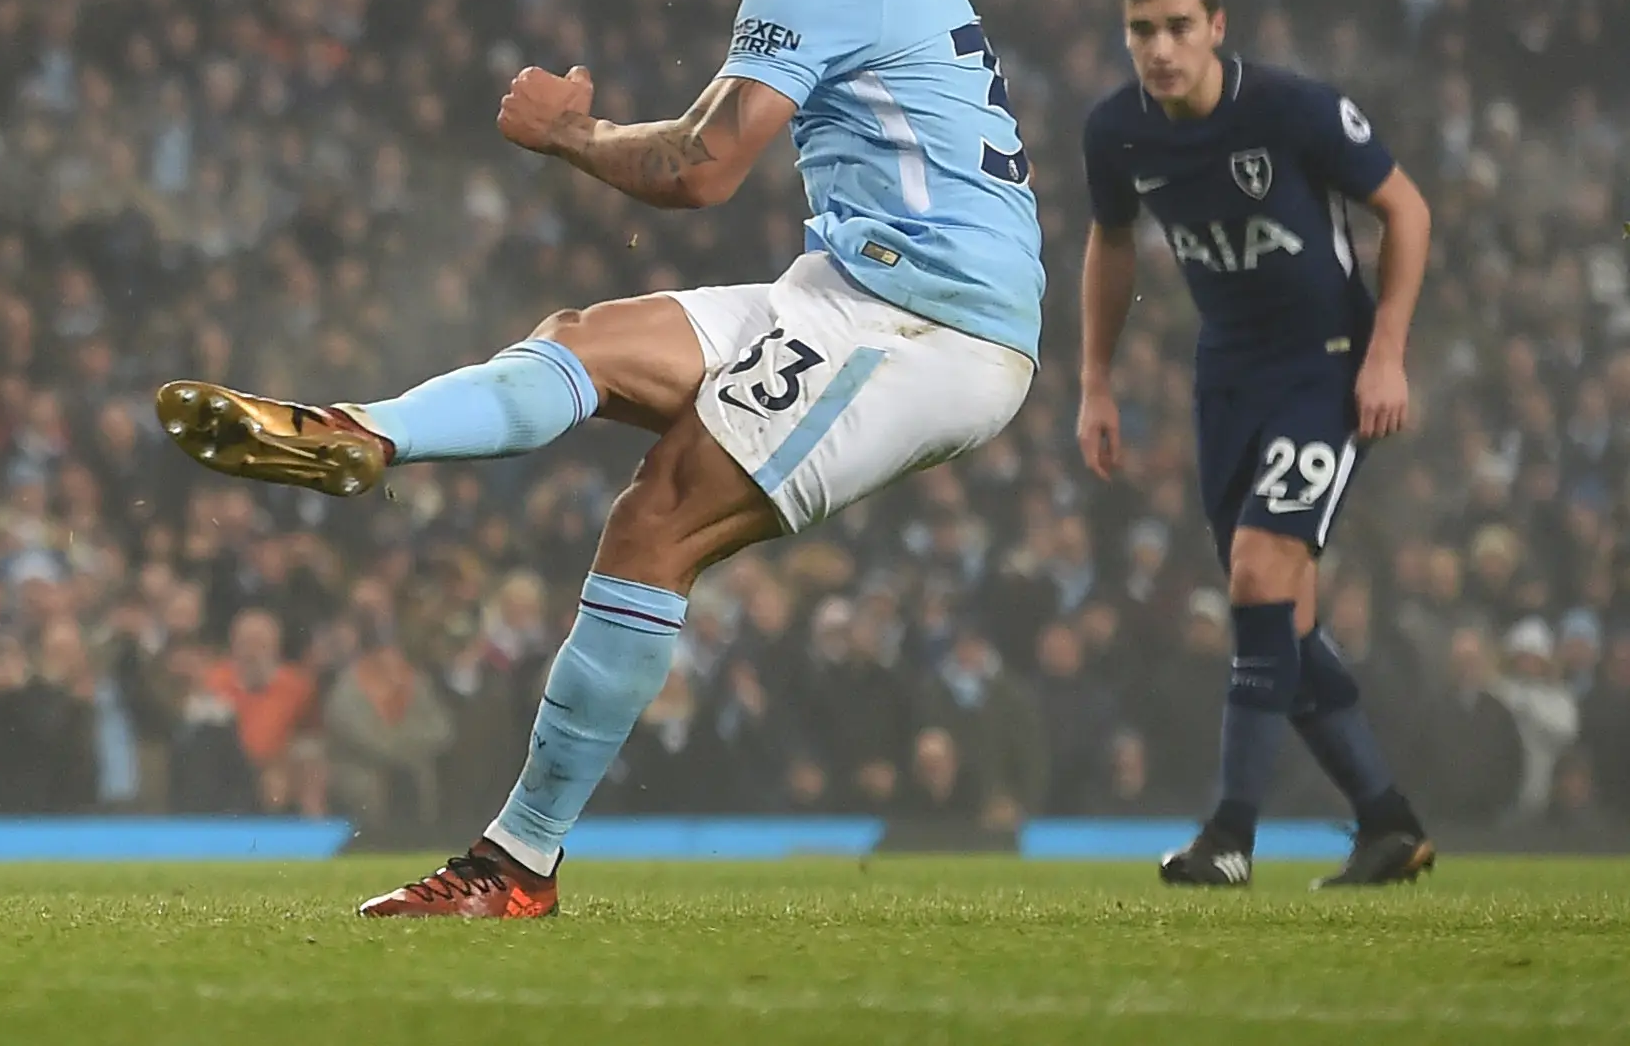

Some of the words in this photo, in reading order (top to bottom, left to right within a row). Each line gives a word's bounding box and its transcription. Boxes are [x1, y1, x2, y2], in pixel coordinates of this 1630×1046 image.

[734, 19, 802, 52] EXEN
[1172, 215, 1303, 272] AIA
[1256, 436, 1336, 505] 29
